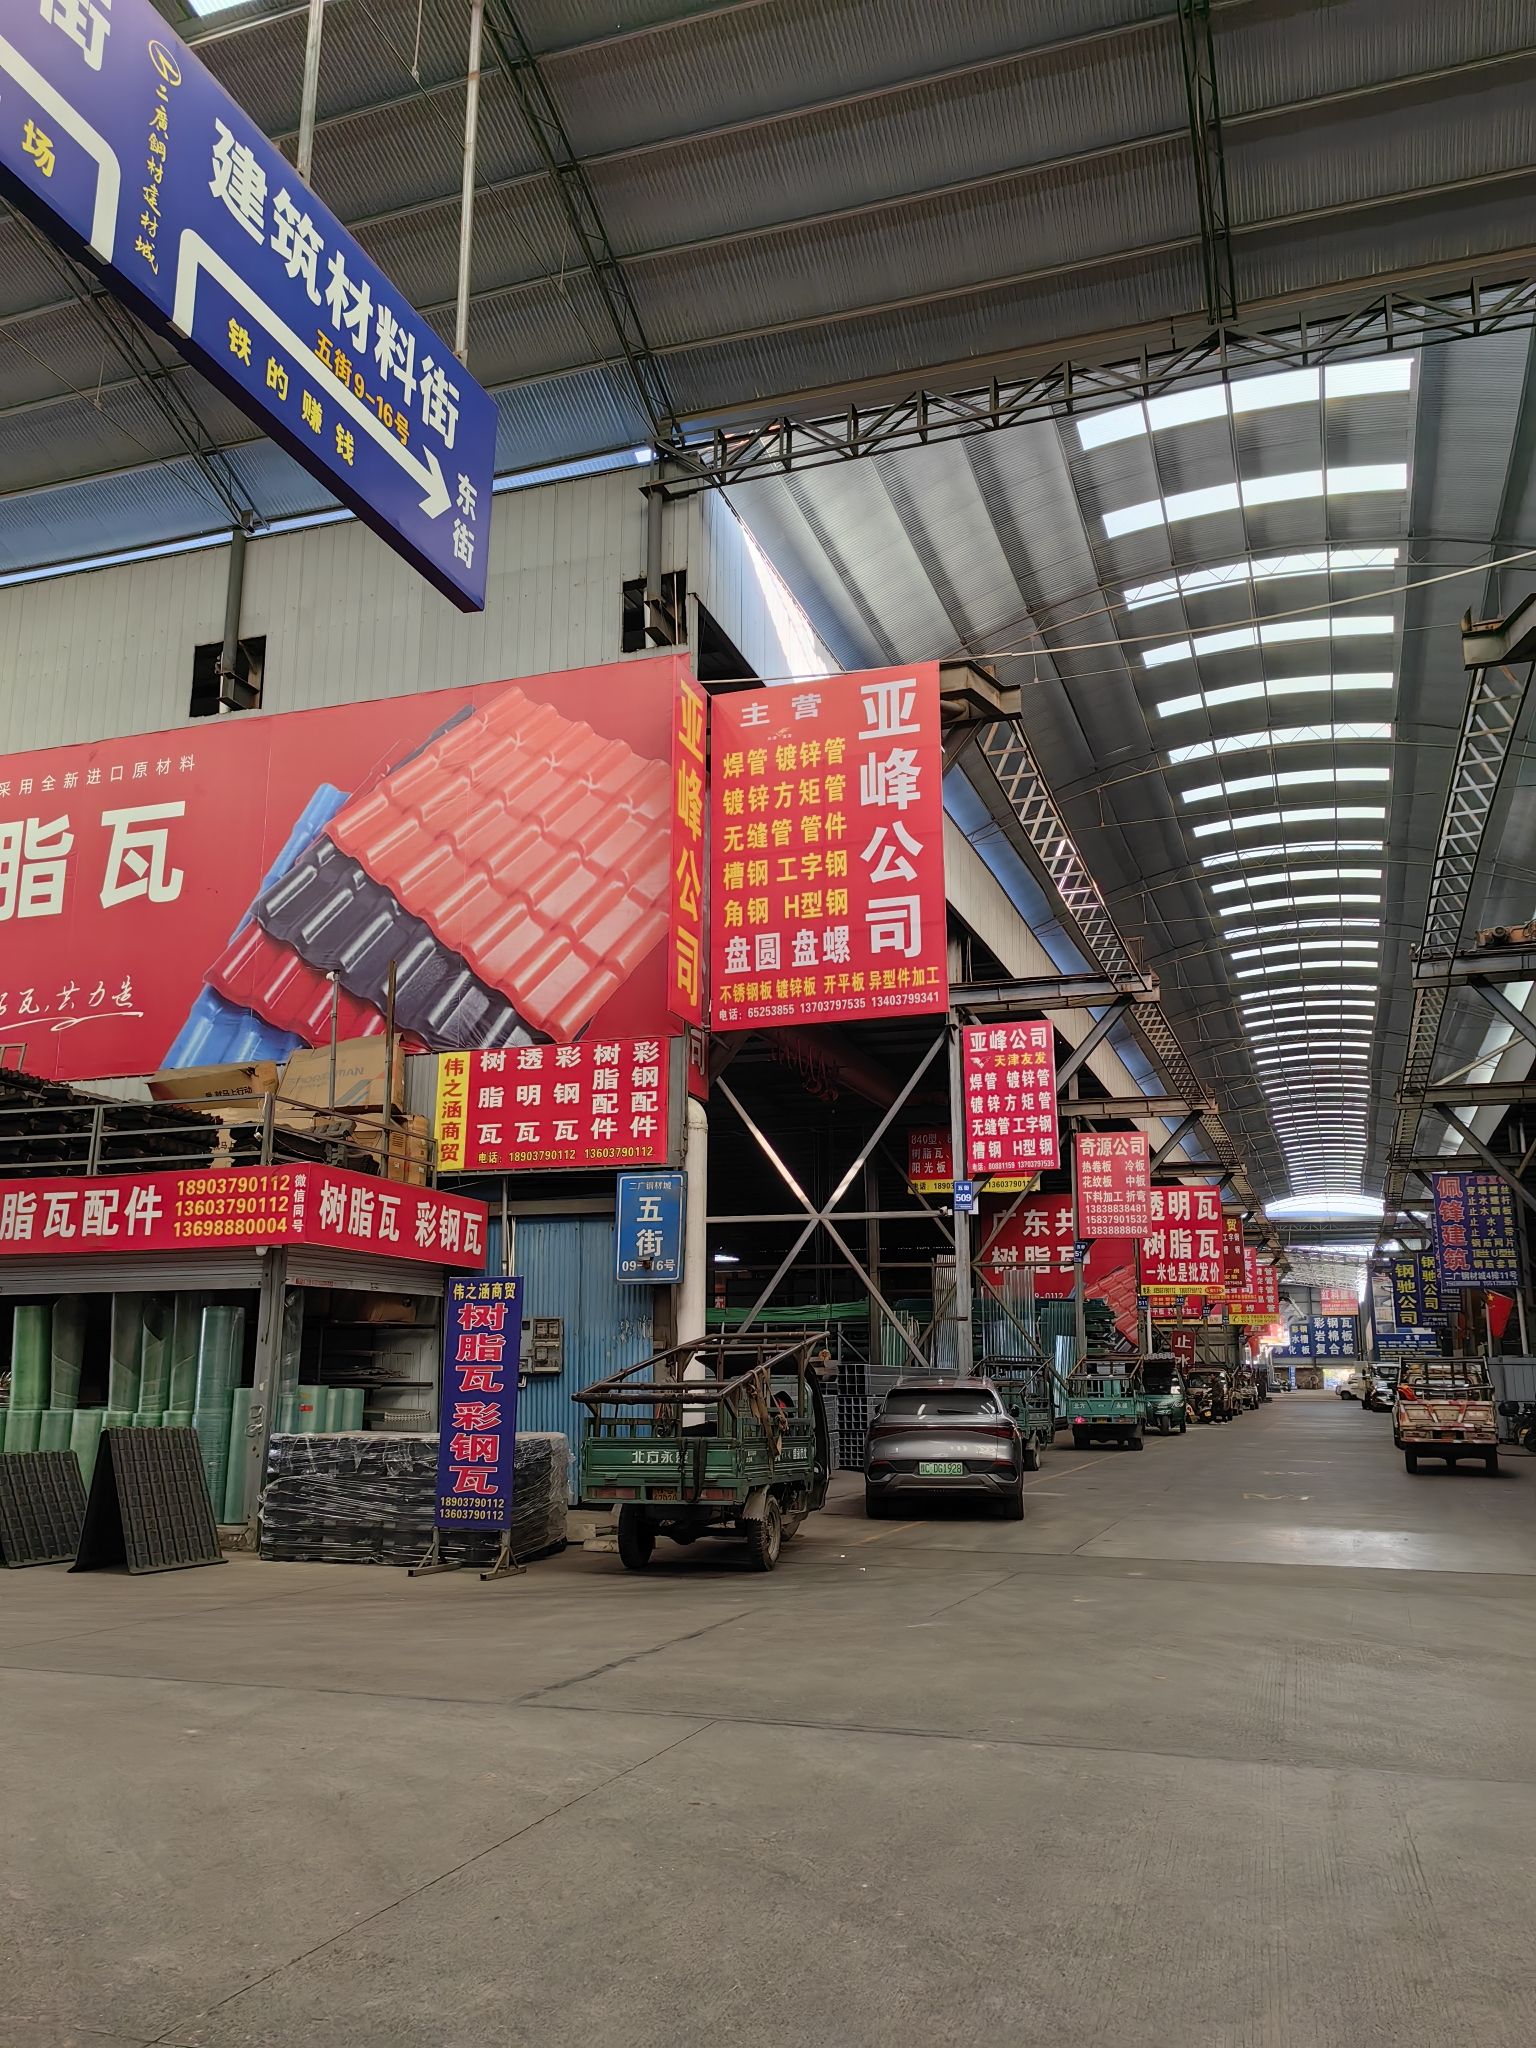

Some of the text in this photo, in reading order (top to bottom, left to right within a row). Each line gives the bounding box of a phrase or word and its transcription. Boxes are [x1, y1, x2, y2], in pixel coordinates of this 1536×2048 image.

[22, 118, 56, 177] 场
[209, 117, 460, 450] 建筑材料街
[227, 318, 355, 466] 铁的赚钱
[315, 329, 411, 447] 五街9-16号
[452, 473, 478, 569] 东街
[739, 693, 823, 728] 主营
[0, 754, 196, 798] 采用全新进口原材料
[723, 737, 846, 779] 焊管 镀锌管
[723, 774, 846, 816] 镀锌方矩管
[723, 812, 847, 852] 无缝管 管件
[858, 678, 924, 959] 亚峰公司
[0, 800, 186, 921] 脂瓦
[676, 678, 703, 1006] 亚峰公司
[723, 850, 848, 891] 槽钢 工字钢
[724, 888, 849, 928] 角钢 H型钢
[724, 925, 851, 974] 盘圆 盘螺
[719, 967, 940, 1004] 不锈钢板 镀锌板 开平板 异型件加工
[748, 1003, 795, 1018] 65253855
[800, 997, 866, 1013] 13703797535
[871, 991, 939, 1007] 13403799341
[970, 1026, 1047, 1053] 亚峰公司
[995, 1052, 1047, 1067] 天津友发
[477, 1051, 507, 1145] 树脂瓦
[515, 1048, 543, 1143] 透明瓦
[553, 1046, 582, 1142] 彩钢瓦
[590, 1044, 620, 1140] 树脂配件
[630, 1041, 659, 1138] 彩钢配件
[970, 1069, 1050, 1091] 焊管 镀锌管
[440, 1058, 464, 1162] 伟之涵商贸
[971, 1092, 1051, 1113] 镀锌方矩管
[972, 1115, 1051, 1136] 无缝管 工字钢
[509, 1150, 576, 1162] 18903790112
[584, 1147, 654, 1159] 13603790112
[973, 1138, 1053, 1159] 槽钢 H型钢
[1080, 1136, 1145, 1157] 奇源公司
[1082, 1160, 1146, 1173] 热卷板 冷板
[177, 1174, 290, 1196] 18903790112
[1082, 1175, 1146, 1188] 花纹板 中板
[1083, 1191, 1123, 1203] 下料加工
[0, 1185, 163, 1241] 脂瓦配件
[175, 1196, 289, 1217] 13603790112
[292, 1174, 306, 1233] 微信同号
[319, 1179, 483, 1256] 树脂瓦 彩钢瓦
[1085, 1205, 1147, 1213] 13838838481
[1086, 1215, 1148, 1224] 15837901532
[1151, 1190, 1219, 1221] 透明瓦
[1437, 1177, 1470, 1270] 佩锋建筑
[173, 1217, 288, 1237] 13698880004
[636, 1196, 664, 1257] 五街
[1143, 1228, 1220, 1260] 树脂瓦
[453, 1282, 516, 1300] 伟之涵商贸
[1146, 1262, 1220, 1284] 一米也是批发价
[1421, 1255, 1439, 1310] 钢驰公司
[1395, 1264, 1418, 1325] 钢驰公司
[1314, 1317, 1353, 1329] 彩钢瓦
[1315, 1330, 1354, 1342] 岩棉板
[455, 1302, 509, 1393] 树脂瓦
[1316, 1343, 1354, 1355] 复合板
[449, 1401, 502, 1495] 彩钢瓦
[439, 1508, 504, 1520] 13603790112
[440, 1496, 505, 1508] 18903790112
